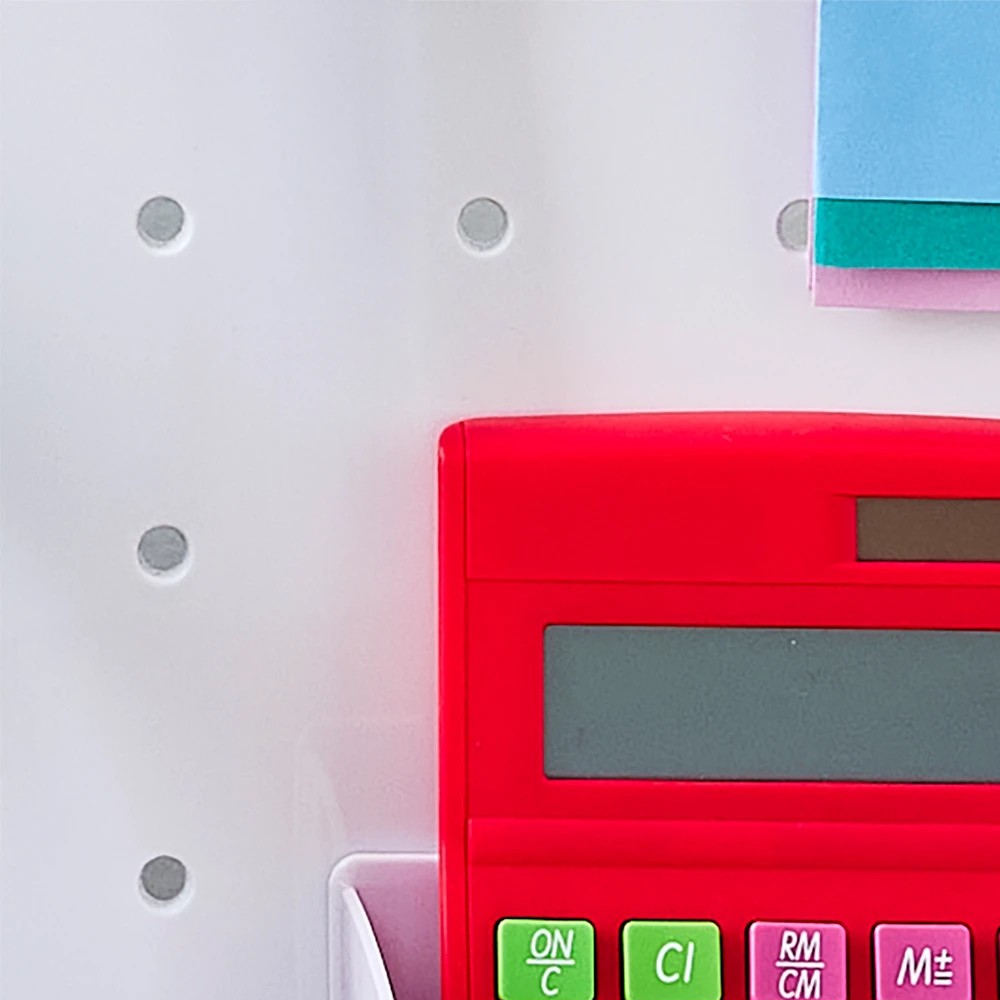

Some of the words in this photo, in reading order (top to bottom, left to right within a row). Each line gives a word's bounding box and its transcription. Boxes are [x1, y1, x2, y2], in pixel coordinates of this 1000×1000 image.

[530, 928, 574, 959] ON
[779, 930, 821, 961] RM
[540, 967, 561, 996] C
[778, 969, 821, 1000] CM
